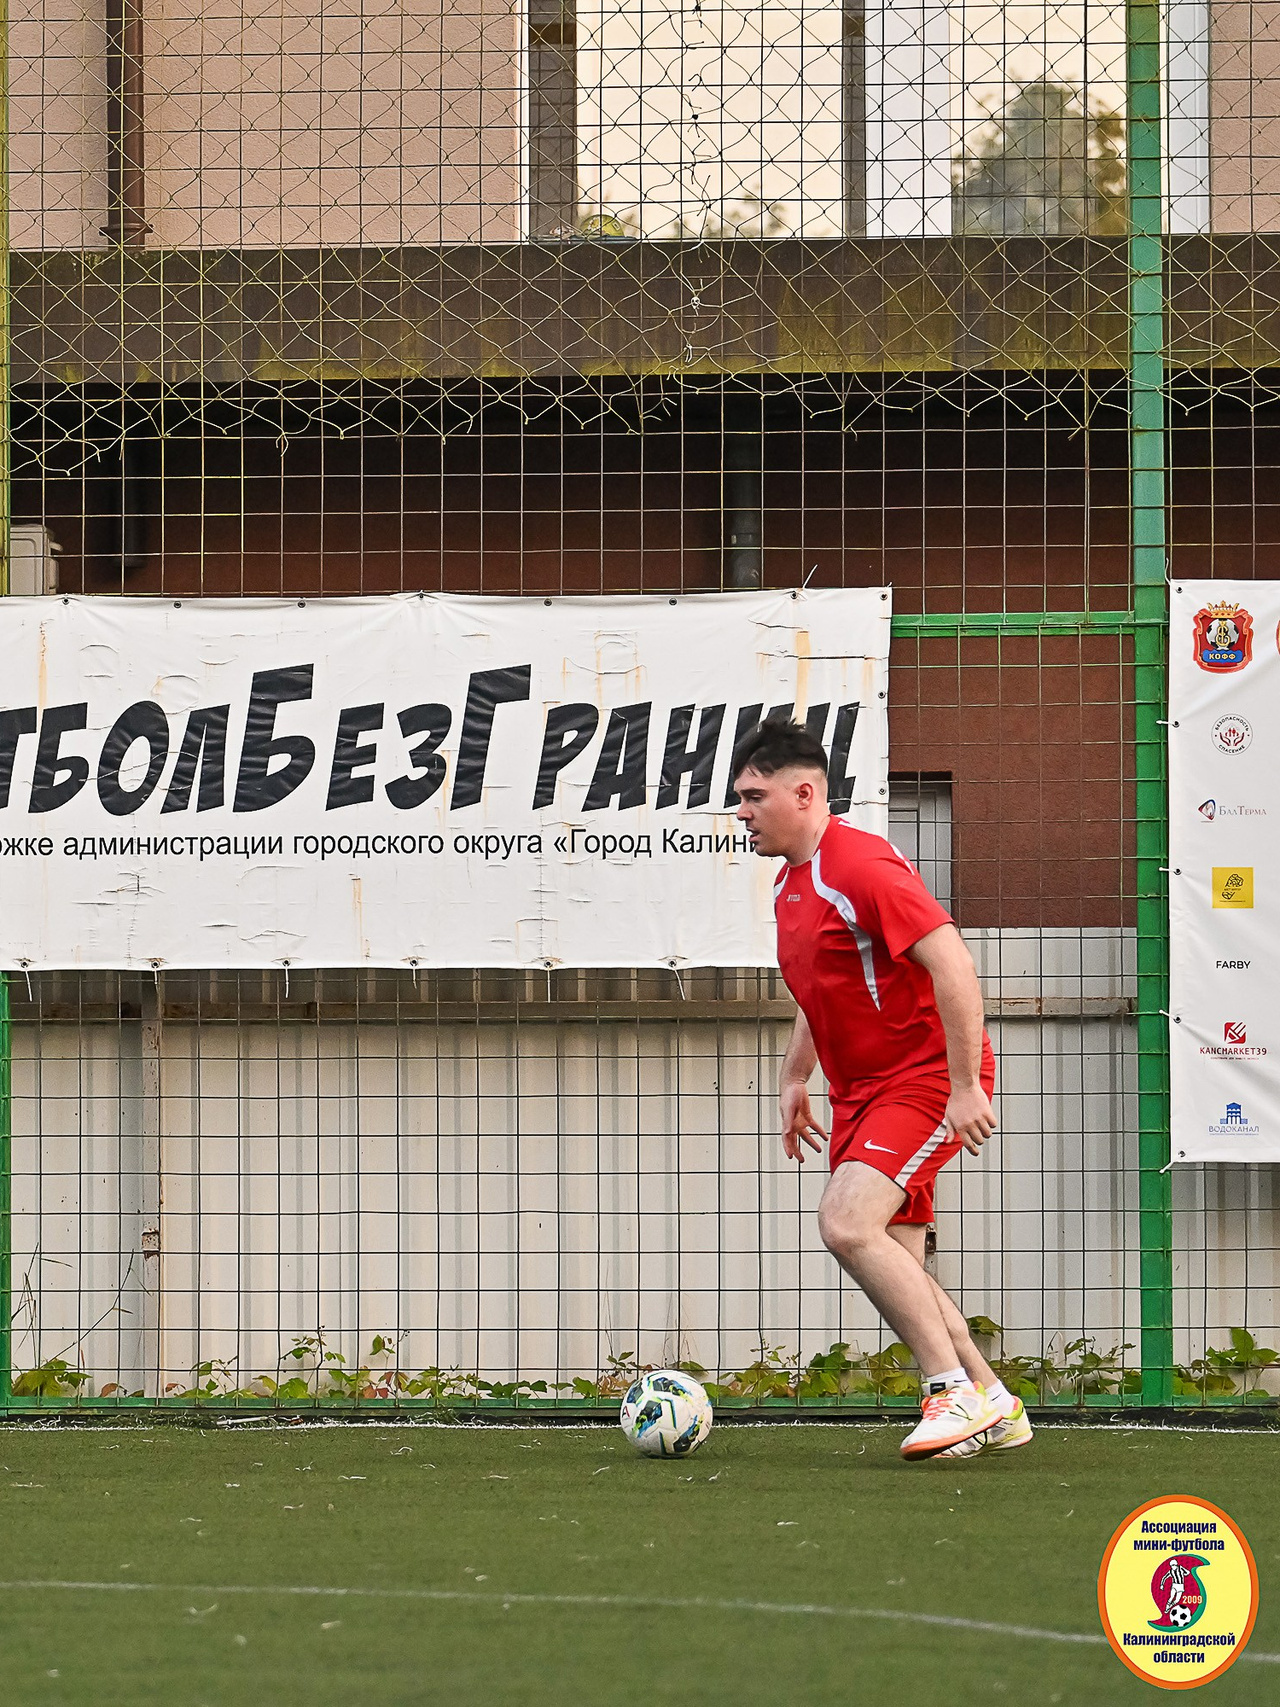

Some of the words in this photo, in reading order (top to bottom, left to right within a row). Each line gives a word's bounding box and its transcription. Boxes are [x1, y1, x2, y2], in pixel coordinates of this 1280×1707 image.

[63, 836, 283, 862] администрации
[294, 835, 443, 862] городского
[454, 834, 543, 862] округа
[554, 828, 652, 858] «Город
[1215, 960, 1251, 970] FARBY
[1208, 1125, 1260, 1133] ВОДОКАНАЛ
